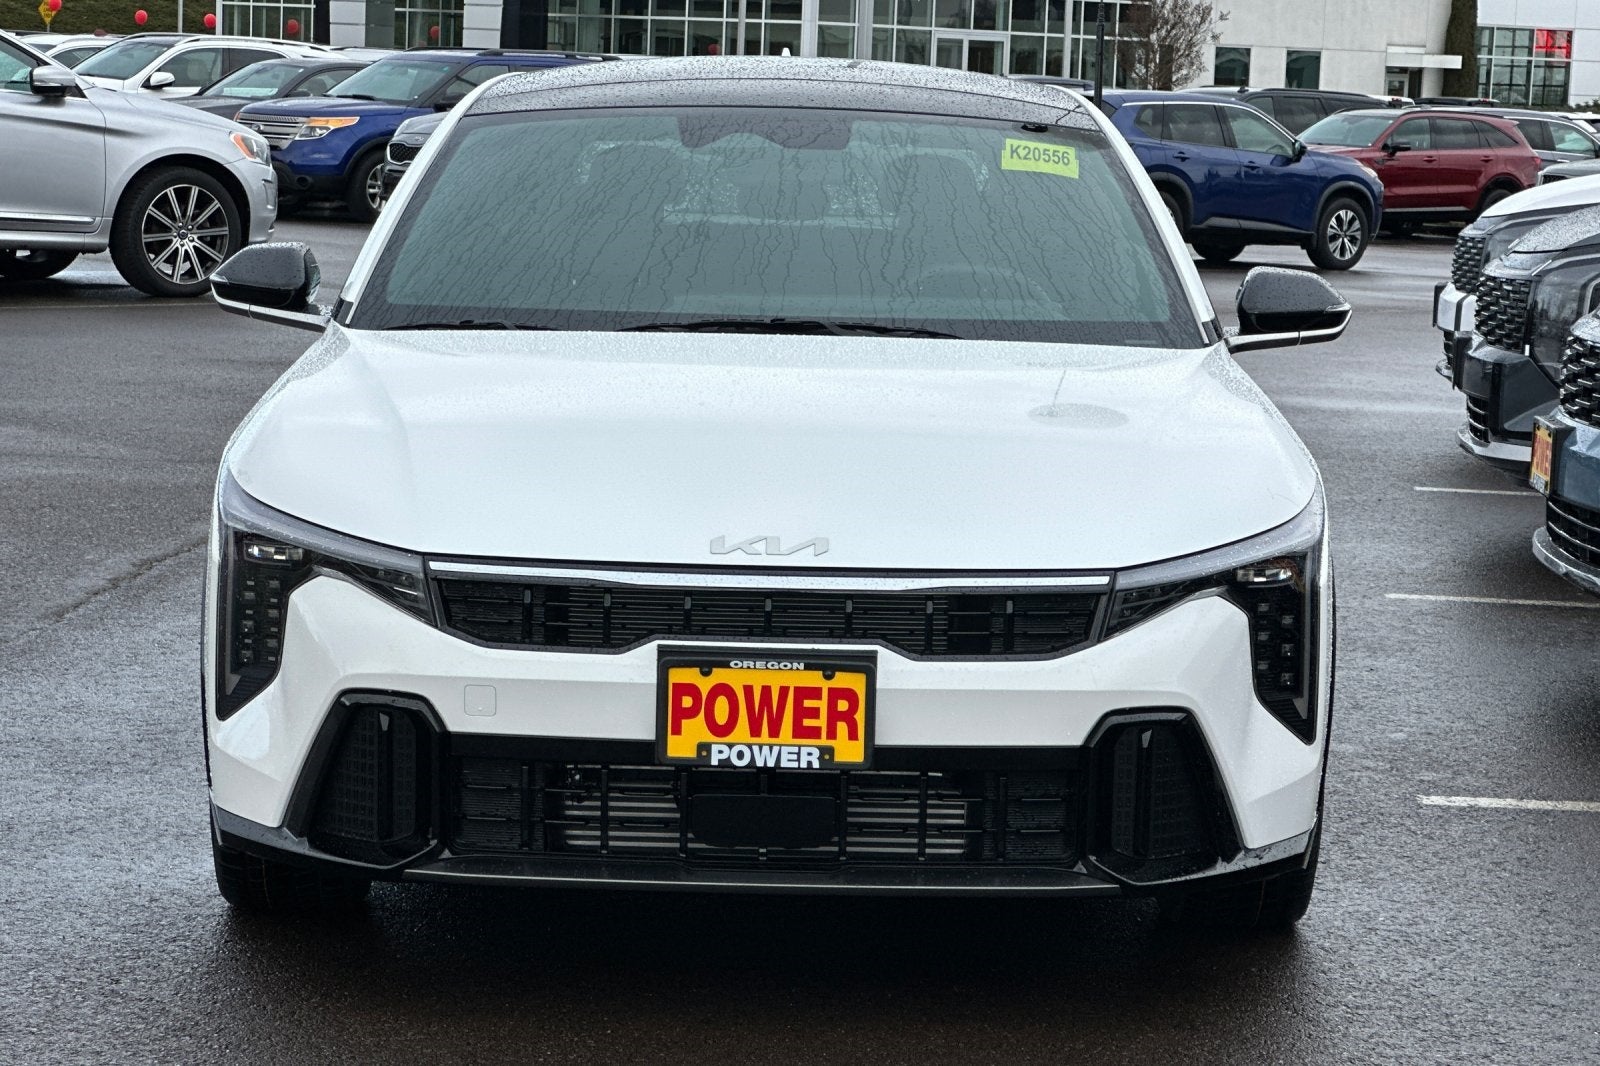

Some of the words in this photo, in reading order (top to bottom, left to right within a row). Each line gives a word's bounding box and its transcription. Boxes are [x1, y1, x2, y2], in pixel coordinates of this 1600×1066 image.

[1010, 144, 1070, 166] K20556
[710, 535, 829, 556] KIA
[729, 660, 805, 671] OREGON
[670, 682, 860, 741] POWER
[710, 744, 820, 769] POWER
